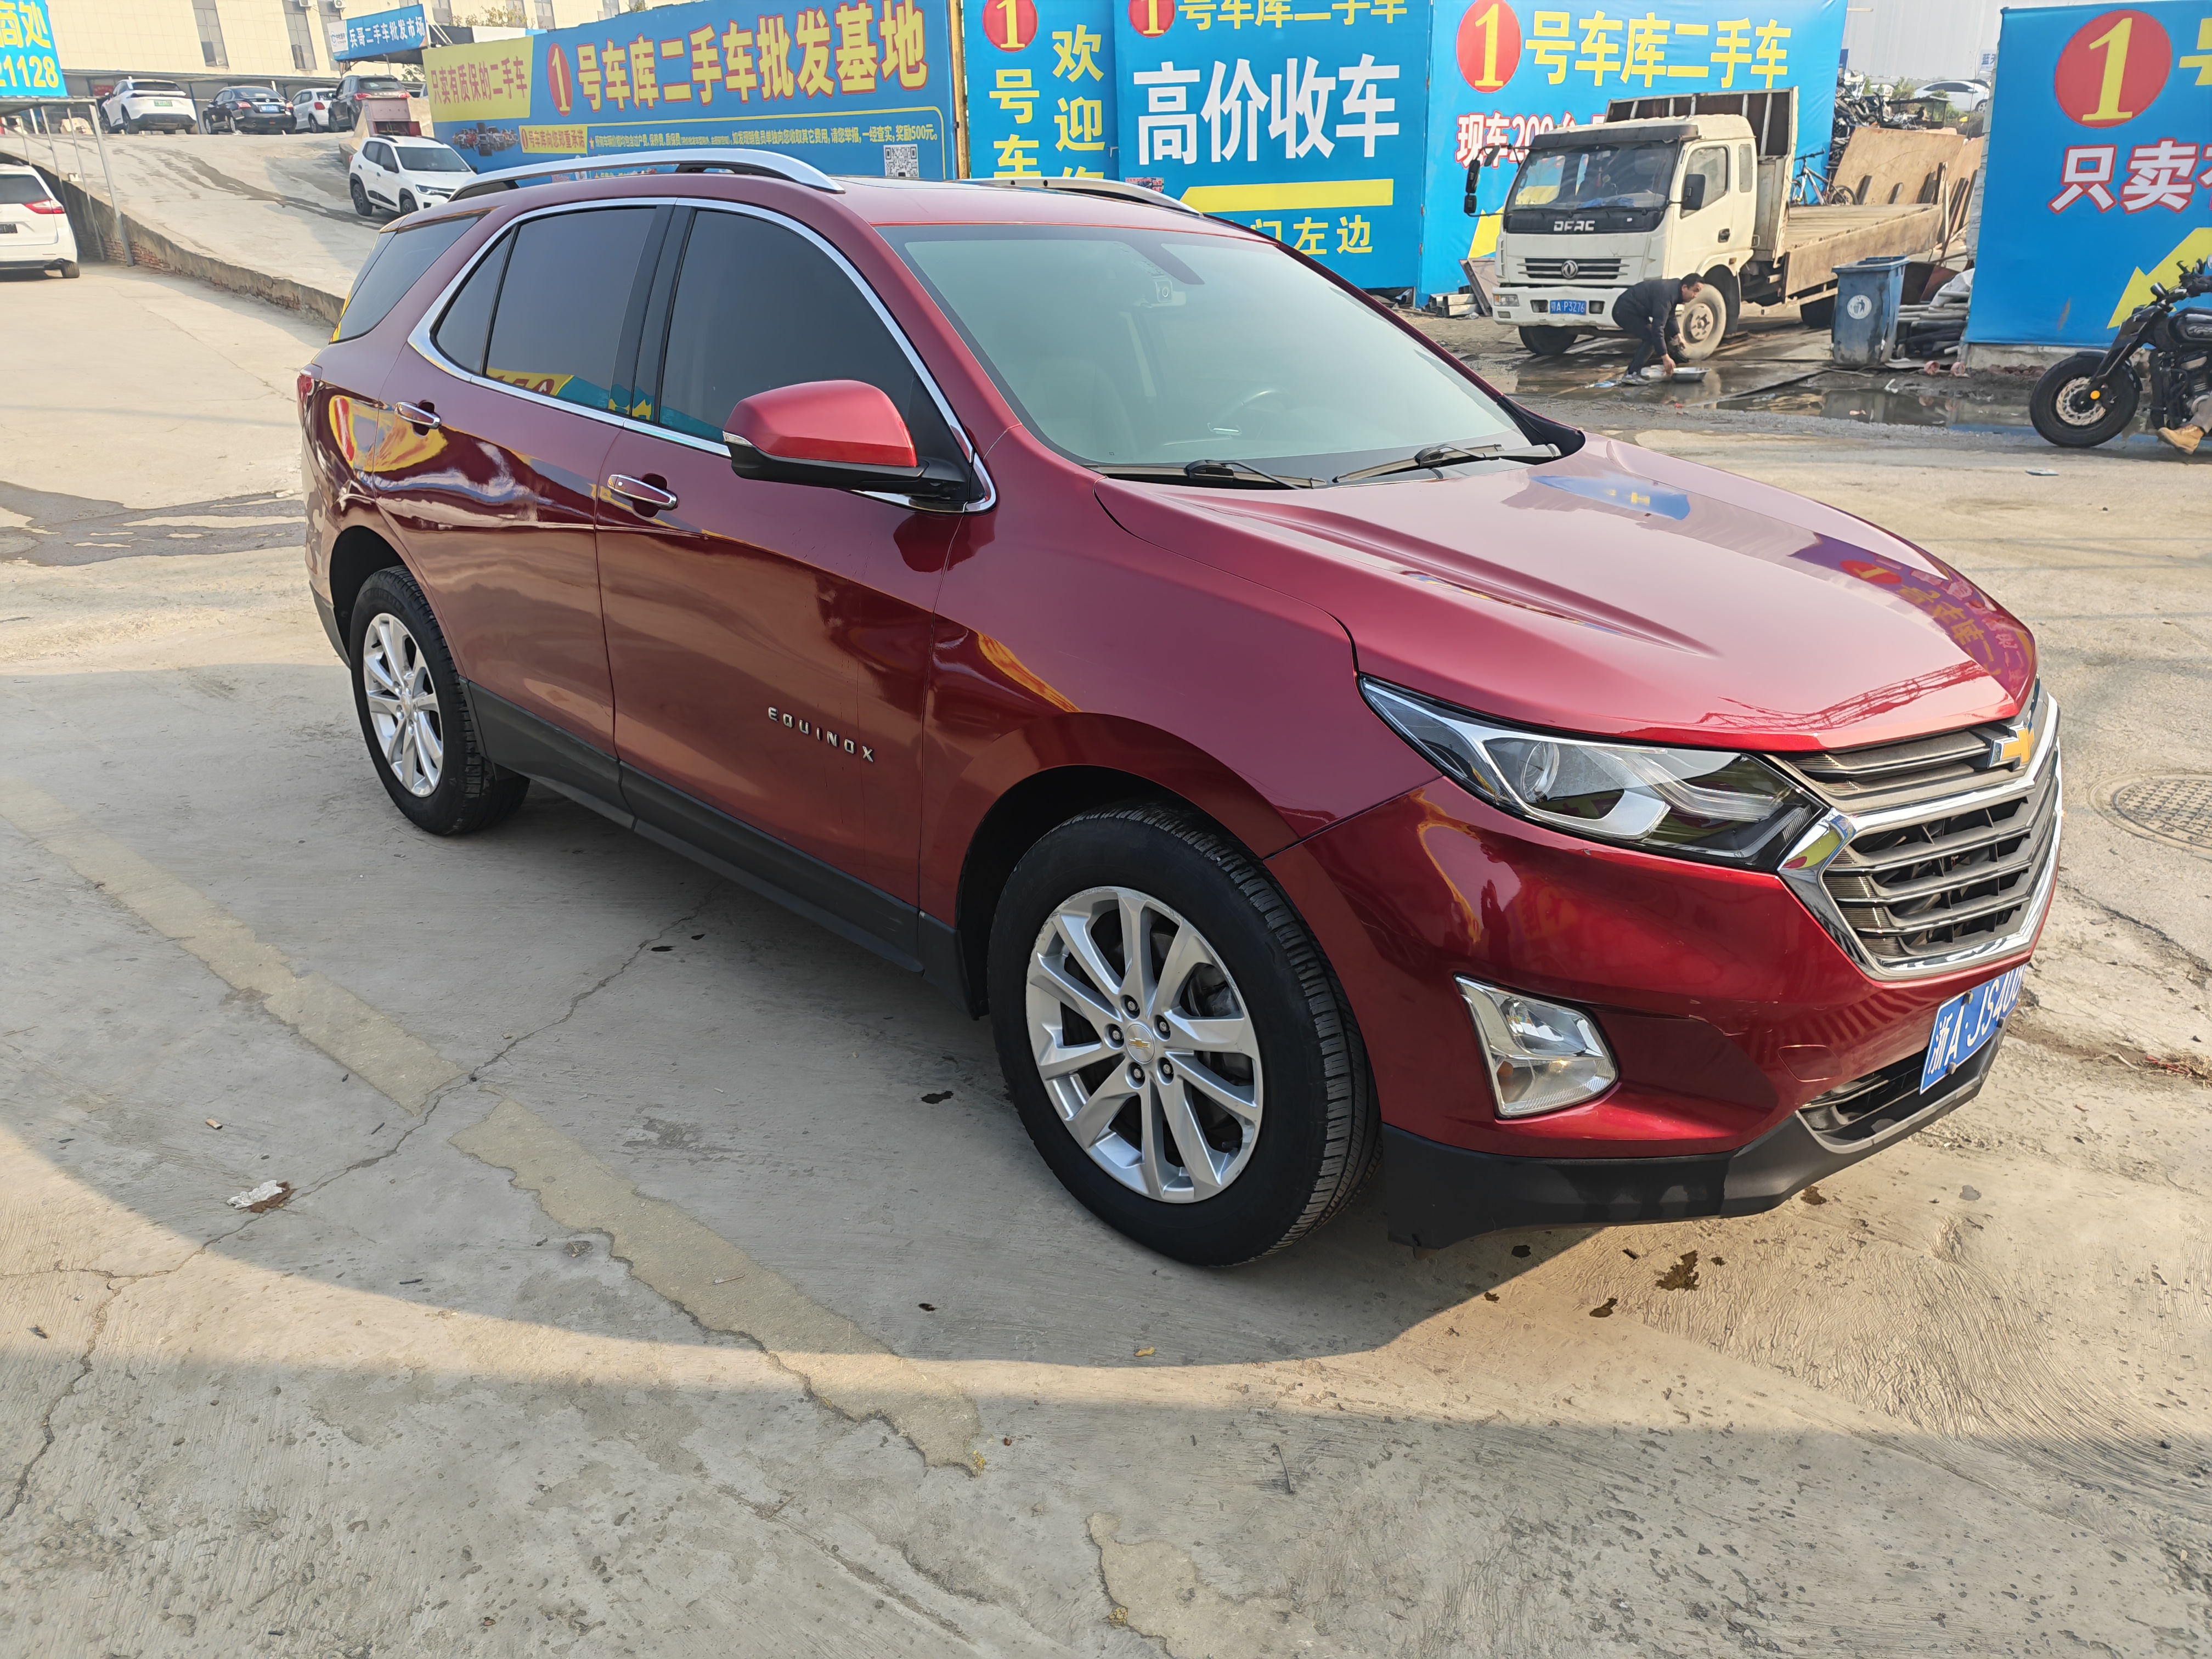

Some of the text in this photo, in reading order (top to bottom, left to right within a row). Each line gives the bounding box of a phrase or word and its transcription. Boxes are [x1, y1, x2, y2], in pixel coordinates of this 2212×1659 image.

[349, 16, 426, 48] 兵哥二手车批发市场
[1475, 3, 1792, 88] 1号车库二手车
[431, 56, 528, 105] 只卖有质保的二手车
[1052, 24, 1105, 178] 欢迎
[1133, 53, 1400, 165] 高价收车
[2047, 137, 2212, 215] 只卖
[1553, 220, 1595, 232] DFAC
[768, 706, 874, 763] EQUINOX
